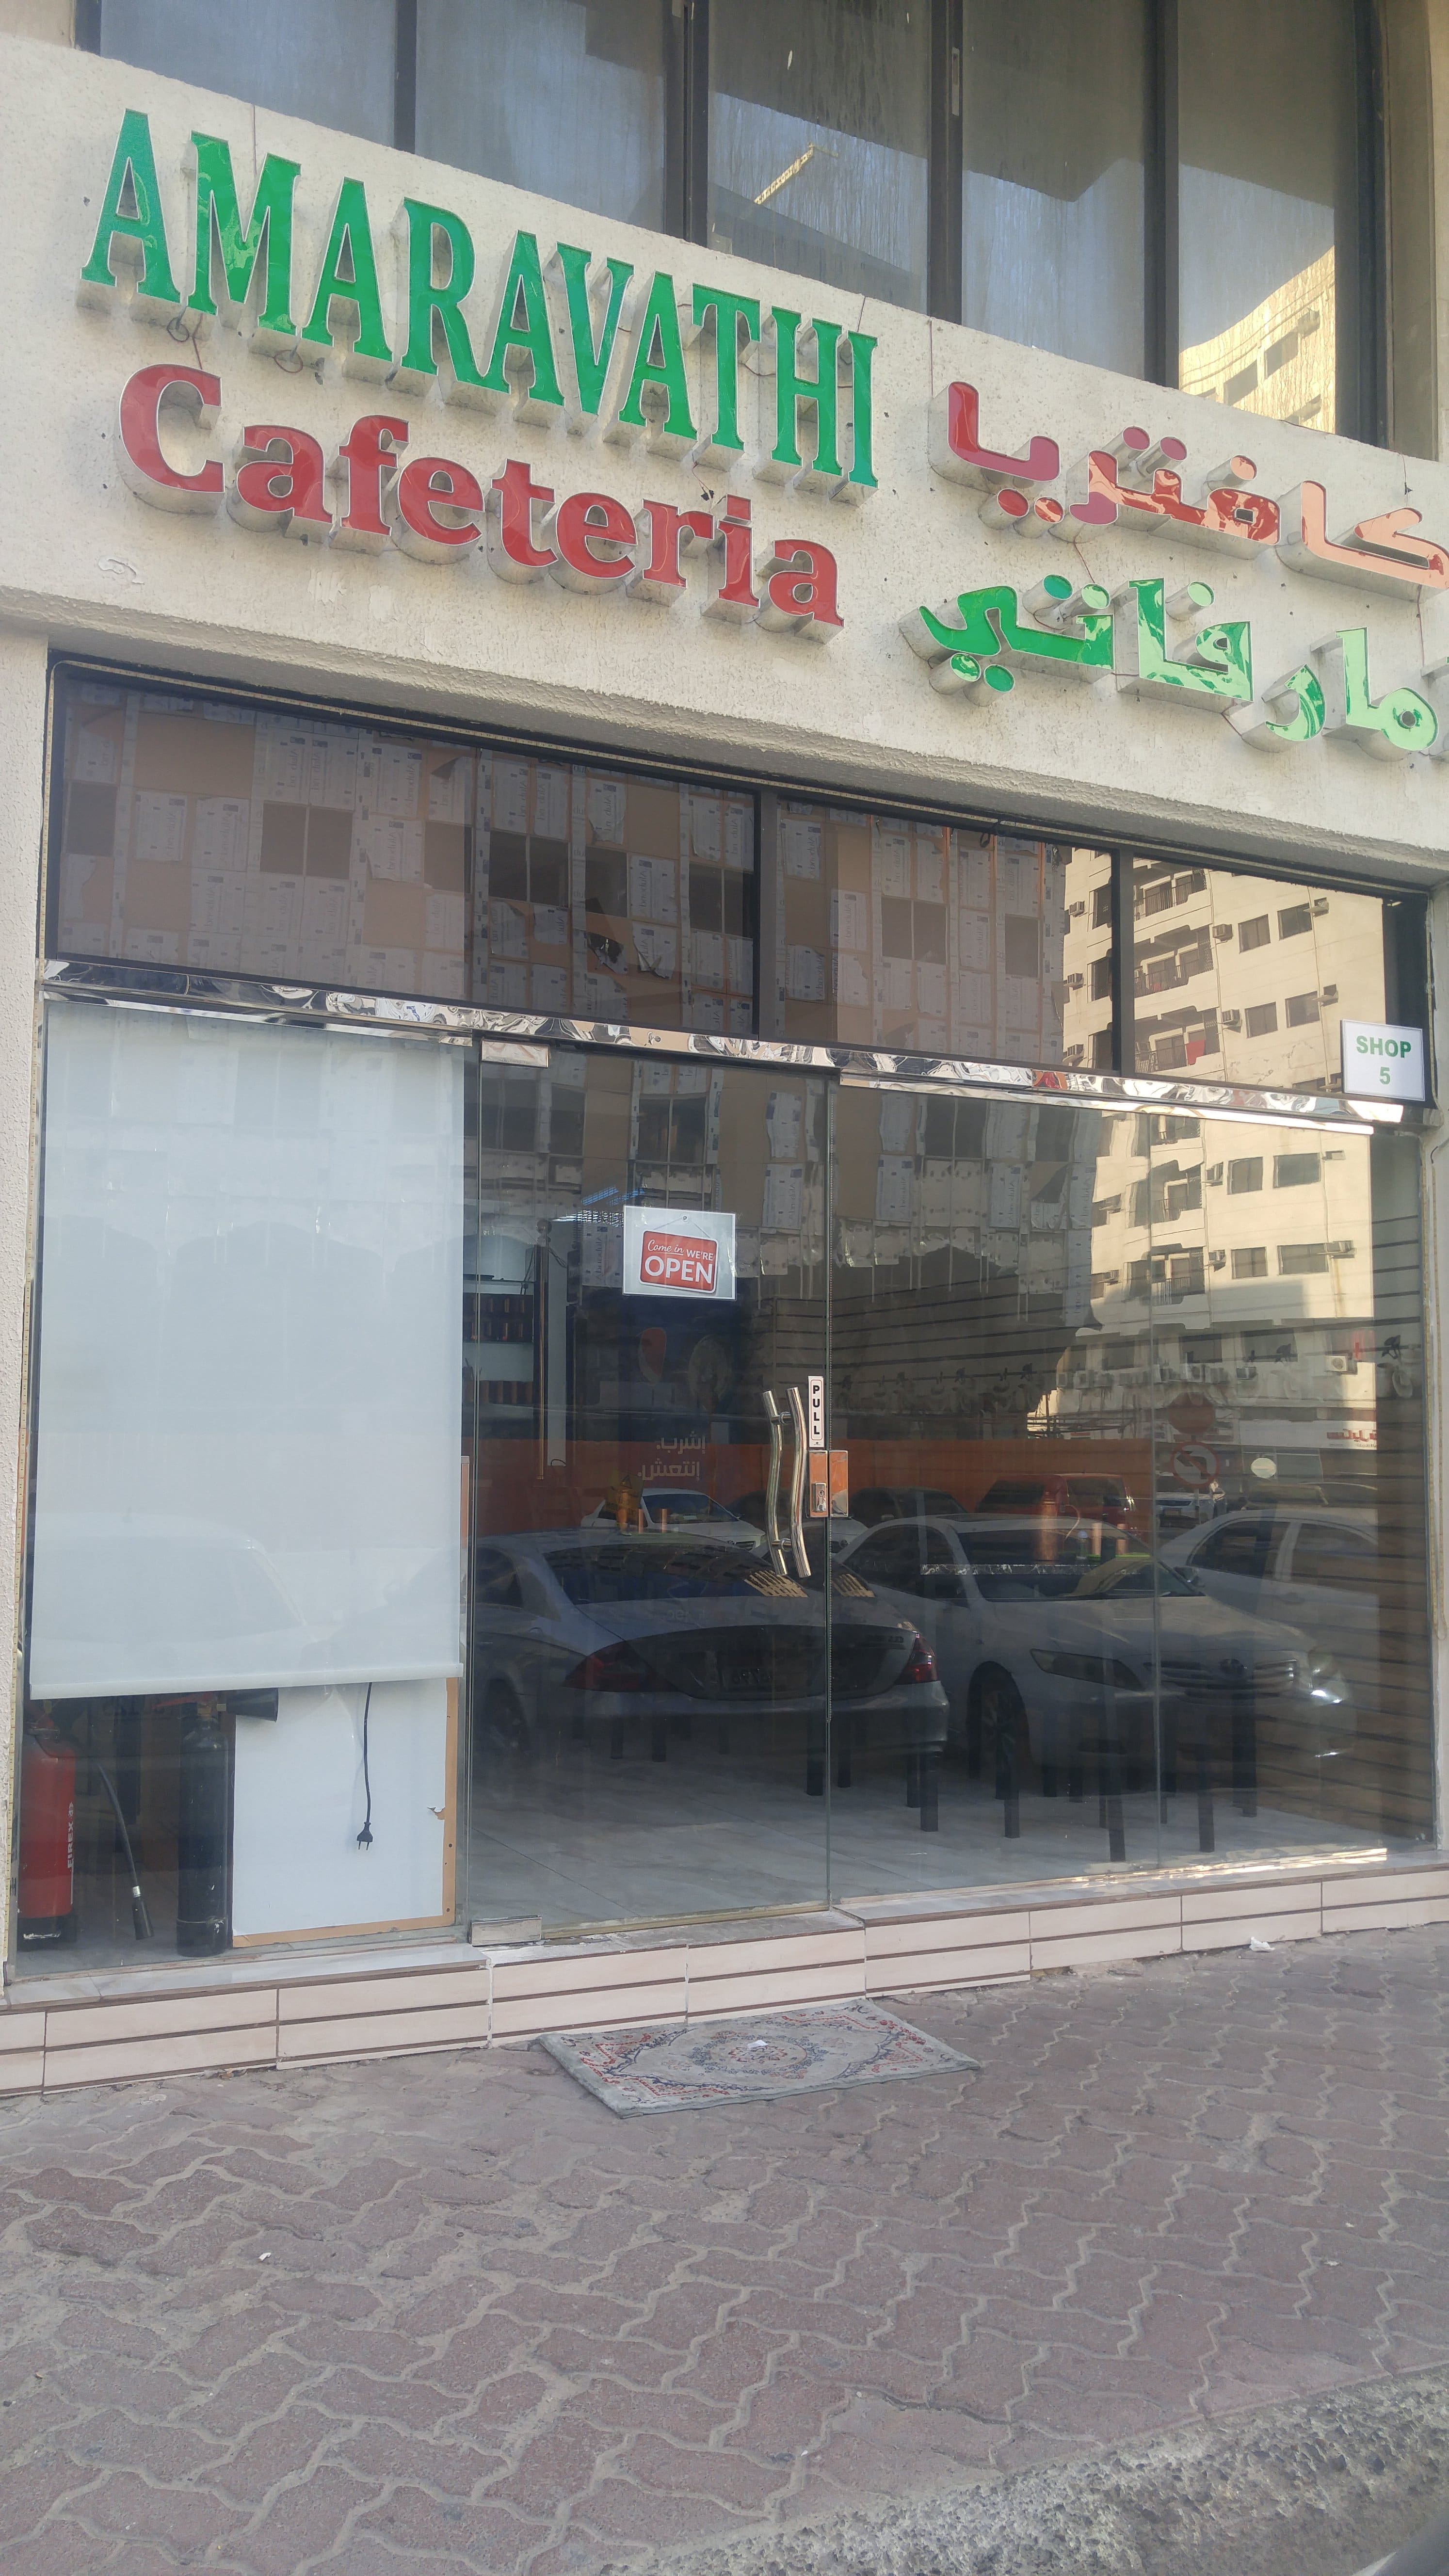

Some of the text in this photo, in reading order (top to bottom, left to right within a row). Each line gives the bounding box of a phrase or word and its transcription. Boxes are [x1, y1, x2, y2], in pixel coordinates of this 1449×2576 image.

[80, 109, 878, 488] AMARAVATHI
[119, 363, 845, 627] Cafeteria
[918, 574, 1449, 752] مارفاتي
[1356, 1035, 1412, 1059] SHOP
[1379, 1066, 1391, 1085] 5
[647, 1240, 714, 1261] Come in WE'RE
[644, 1256, 712, 1284] OPEN
